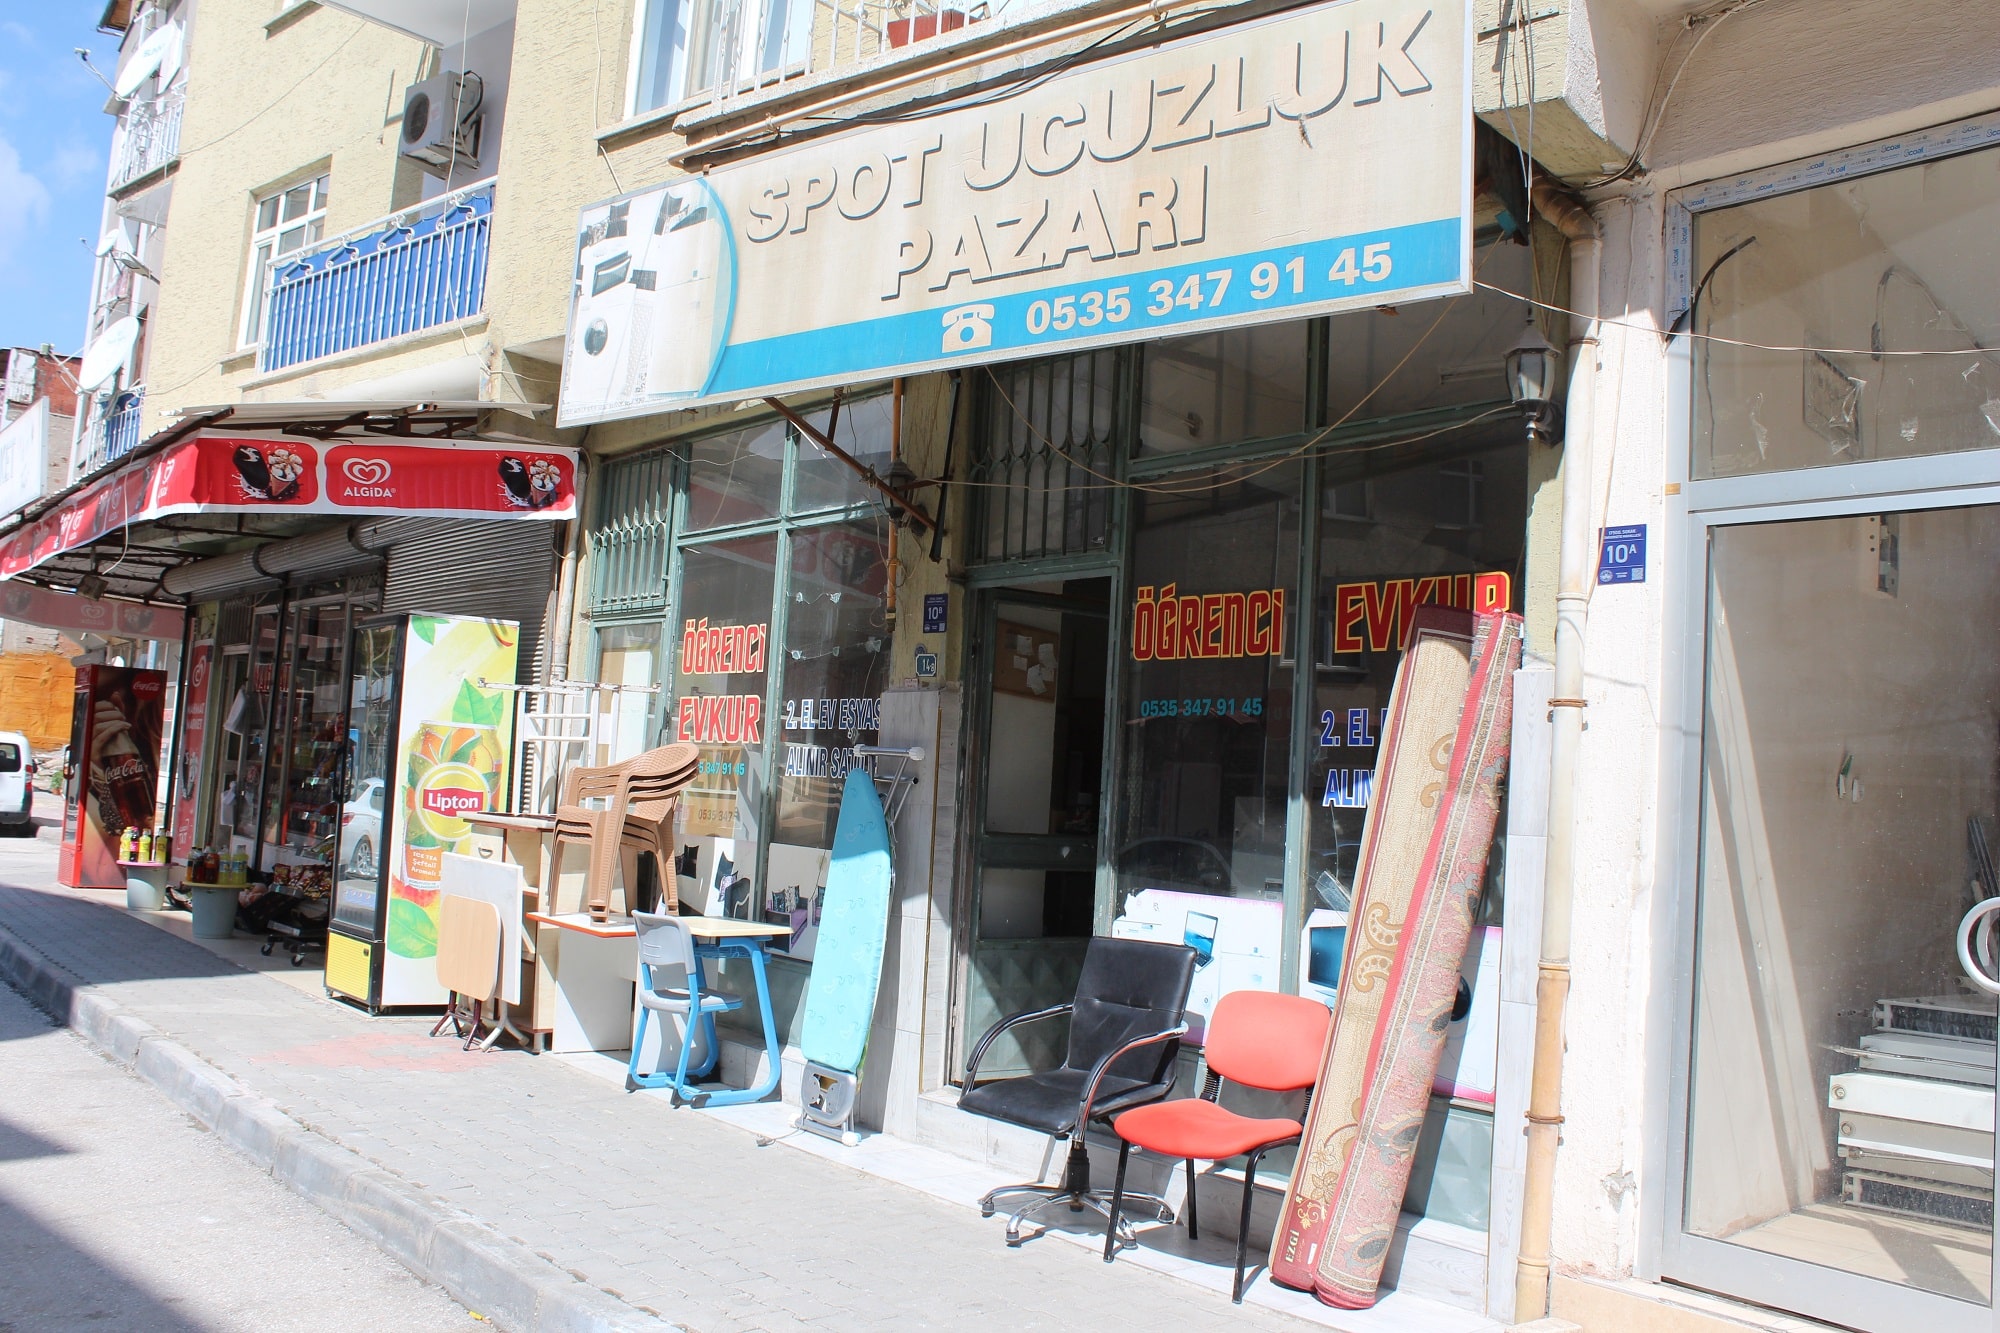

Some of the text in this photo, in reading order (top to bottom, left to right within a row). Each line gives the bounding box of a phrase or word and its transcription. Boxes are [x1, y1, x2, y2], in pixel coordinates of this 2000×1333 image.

[746, 10, 1432, 243] SPOT UCUZLUK
[881, 165, 1208, 301] PAZARI
[1026, 240, 1393, 336] 0535 347 91 45
[677, 694, 761, 744] EVKUR
[785, 698, 880, 738] 2. EL EV EŞYAS
[1141, 697, 1263, 718] 0535 347 91 45
[1320, 709, 1341, 747] 2.
[1347, 708, 1374, 747] EL
[706, 761, 720, 774] 347
[722, 762, 732, 775] 91
[734, 762, 745, 776] 45
[784, 746, 829, 778] ALINIR
[428, 792, 479, 811] Lipton
[1322, 769, 1376, 808] ALIN
